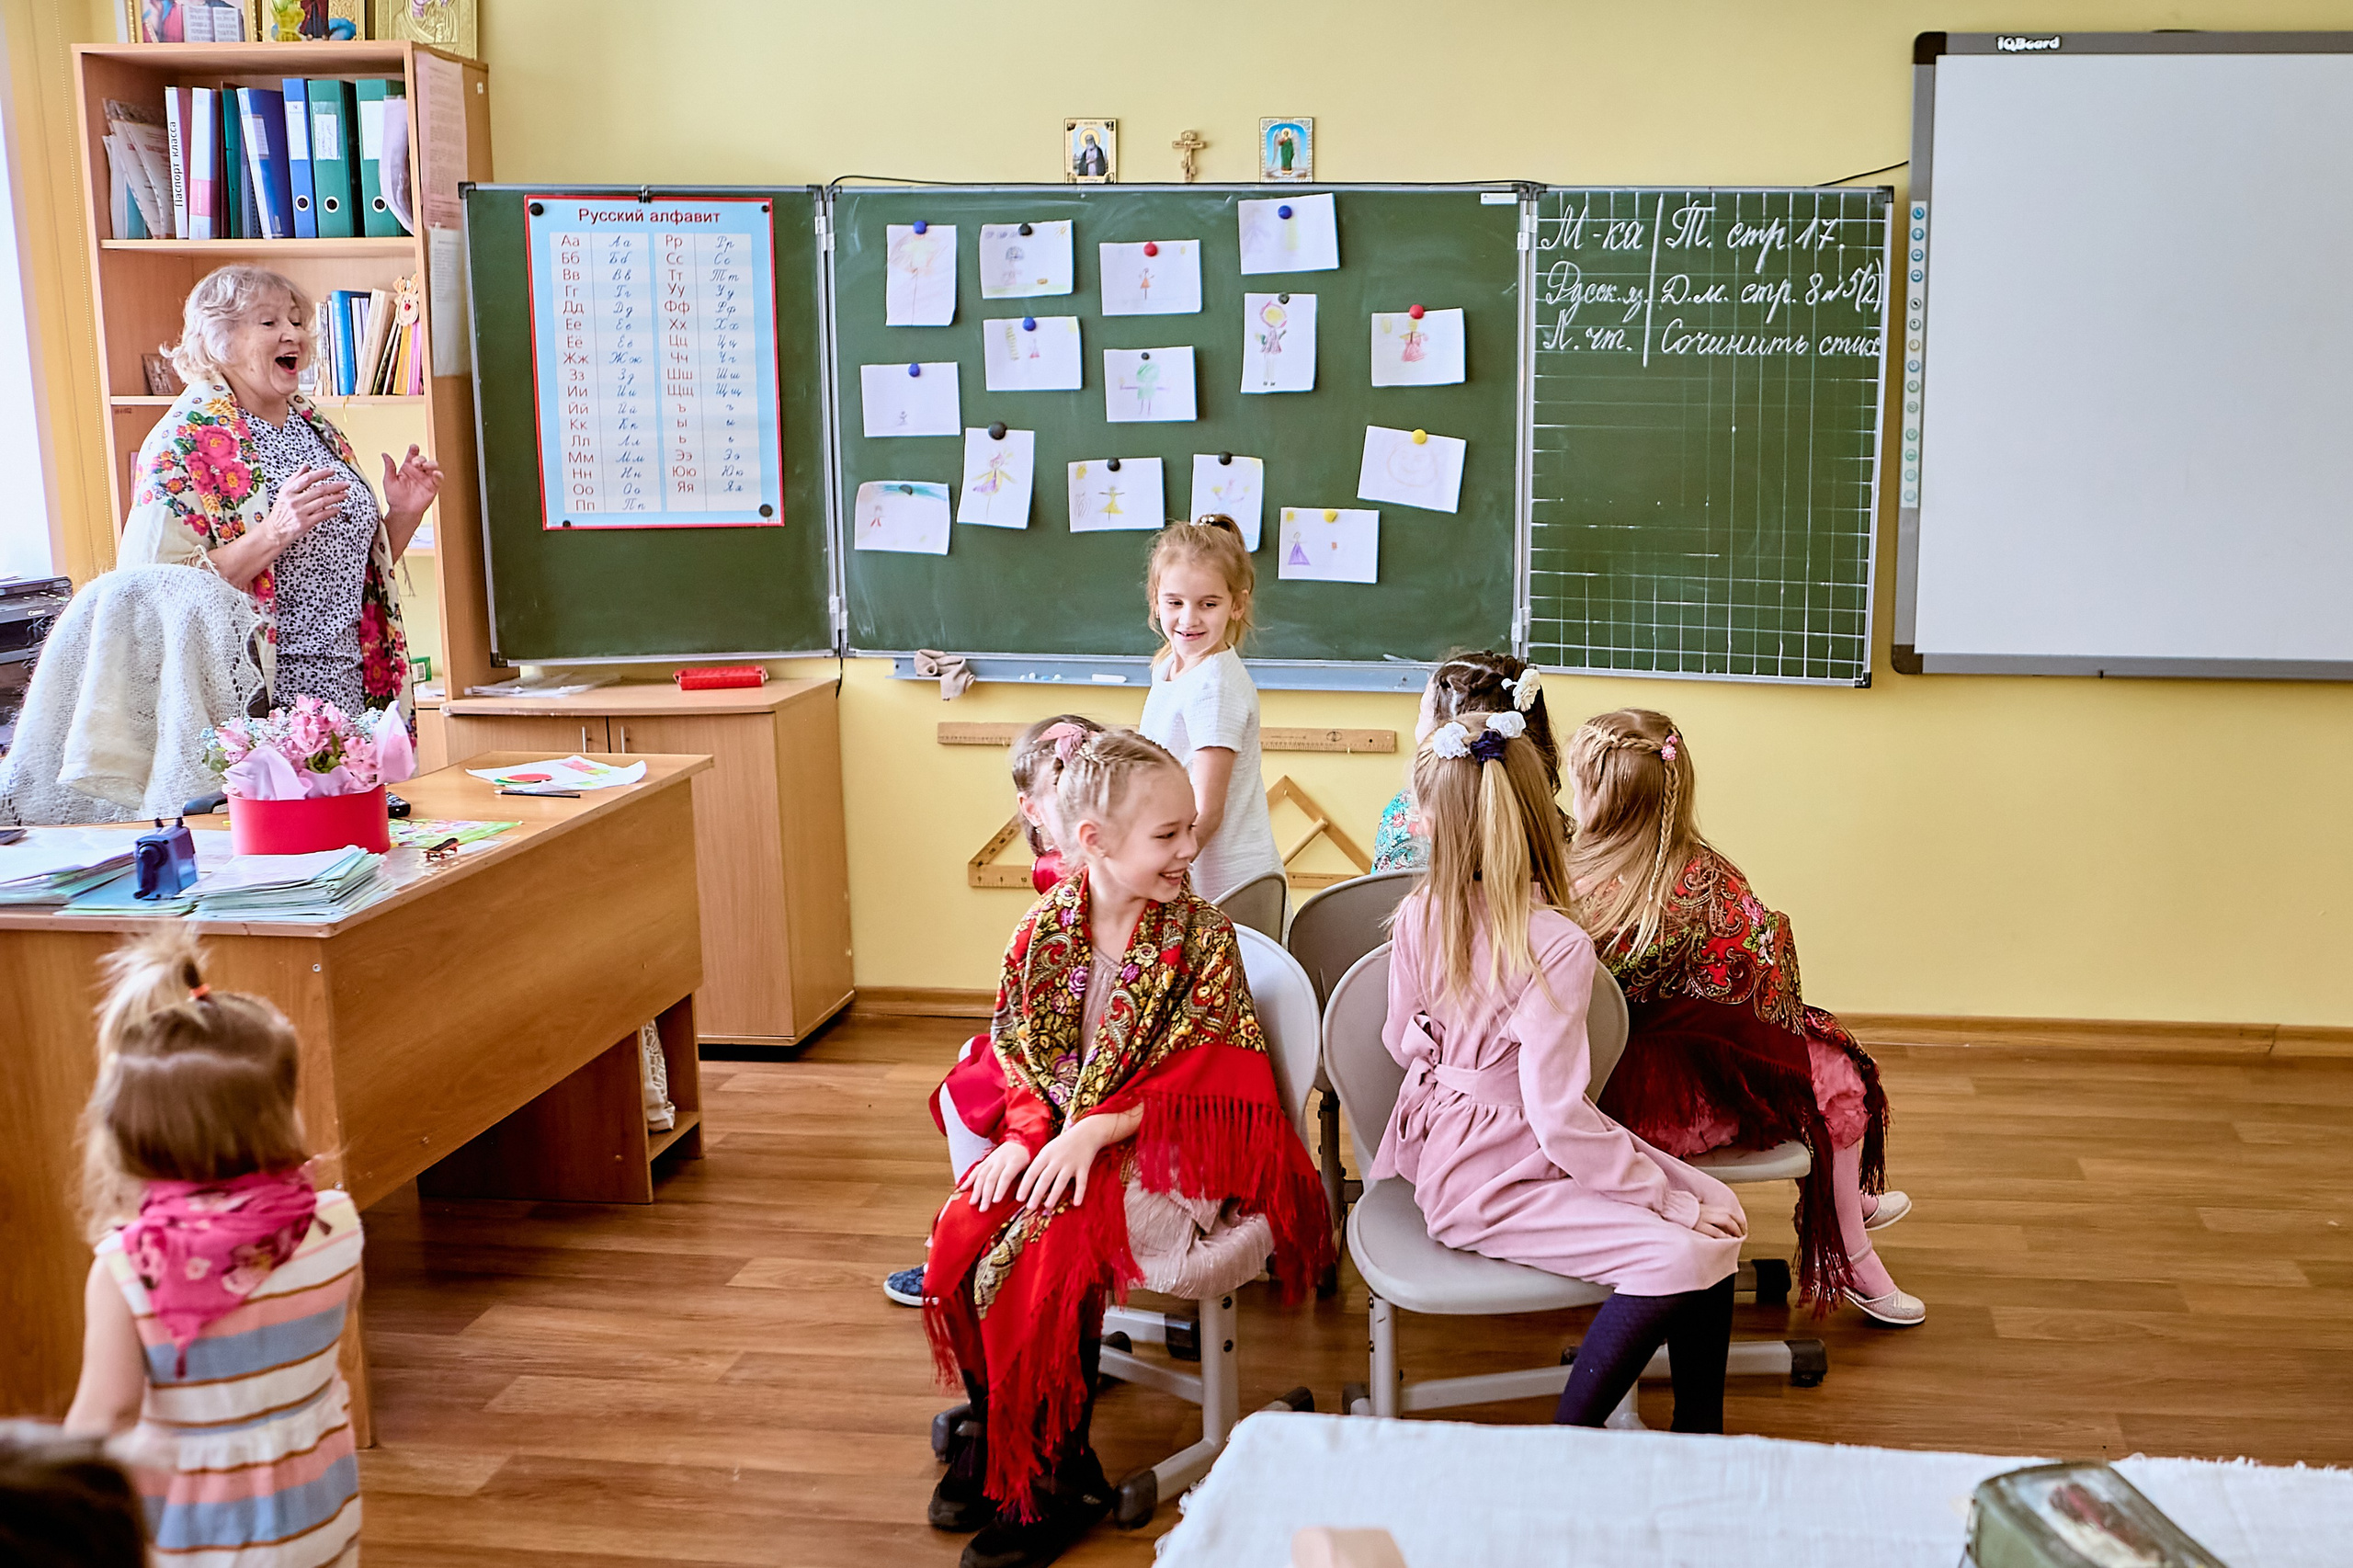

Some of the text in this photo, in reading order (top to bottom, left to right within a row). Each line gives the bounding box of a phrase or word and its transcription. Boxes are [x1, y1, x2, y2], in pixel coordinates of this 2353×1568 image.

[170, 121, 183, 207] Паспорт класса
[579, 209, 720, 225] Русский алфавит
[562, 234, 579, 246] Аа
[666, 234, 682, 250] Рр
[562, 252, 579, 264] Бб
[666, 253, 683, 265] Сс
[563, 268, 580, 280] Вв
[668, 269, 682, 281] Тт
[566, 286, 578, 297] Гг
[668, 283, 685, 298] Уу
[563, 301, 584, 314] Дд
[665, 300, 689, 315] Фф
[566, 318, 581, 330] Ее
[669, 319, 687, 330] Хх
[567, 335, 583, 348] Ёё
[669, 335, 688, 347] Цц
[1661, 318, 1810, 355] Сочинить
[563, 352, 588, 364] Жж
[671, 352, 688, 363] Чч
[570, 369, 585, 381] Зз
[667, 368, 692, 380] Шш
[568, 385, 587, 397] Ии
[667, 384, 694, 397] Щщ
[569, 402, 588, 415] Йй
[571, 419, 587, 430] Кк
[572, 436, 589, 447] Лл
[569, 451, 594, 463] Мм
[676, 449, 692, 461] Ээ
[573, 468, 591, 479] Нн
[673, 466, 696, 477] Юю
[574, 483, 594, 494] Оо
[677, 481, 693, 493] Яя
[576, 500, 595, 511] Пп
